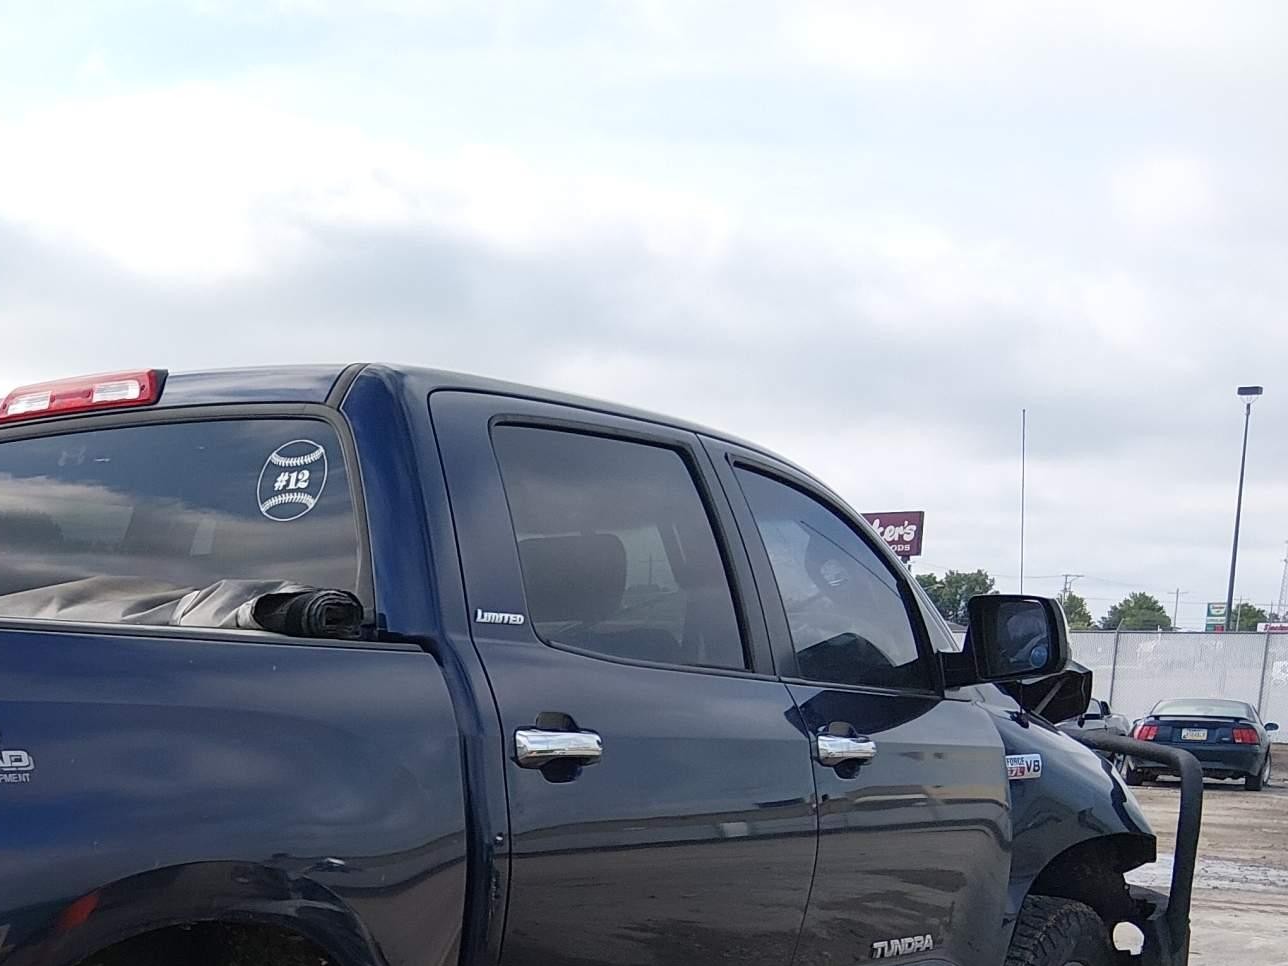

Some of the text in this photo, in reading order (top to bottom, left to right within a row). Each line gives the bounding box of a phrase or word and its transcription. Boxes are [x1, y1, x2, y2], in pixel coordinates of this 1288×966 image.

[274, 470, 310, 490] #12
[1025, 759, 1041, 773] V8
[872, 934, 933, 959] TUNDRA
